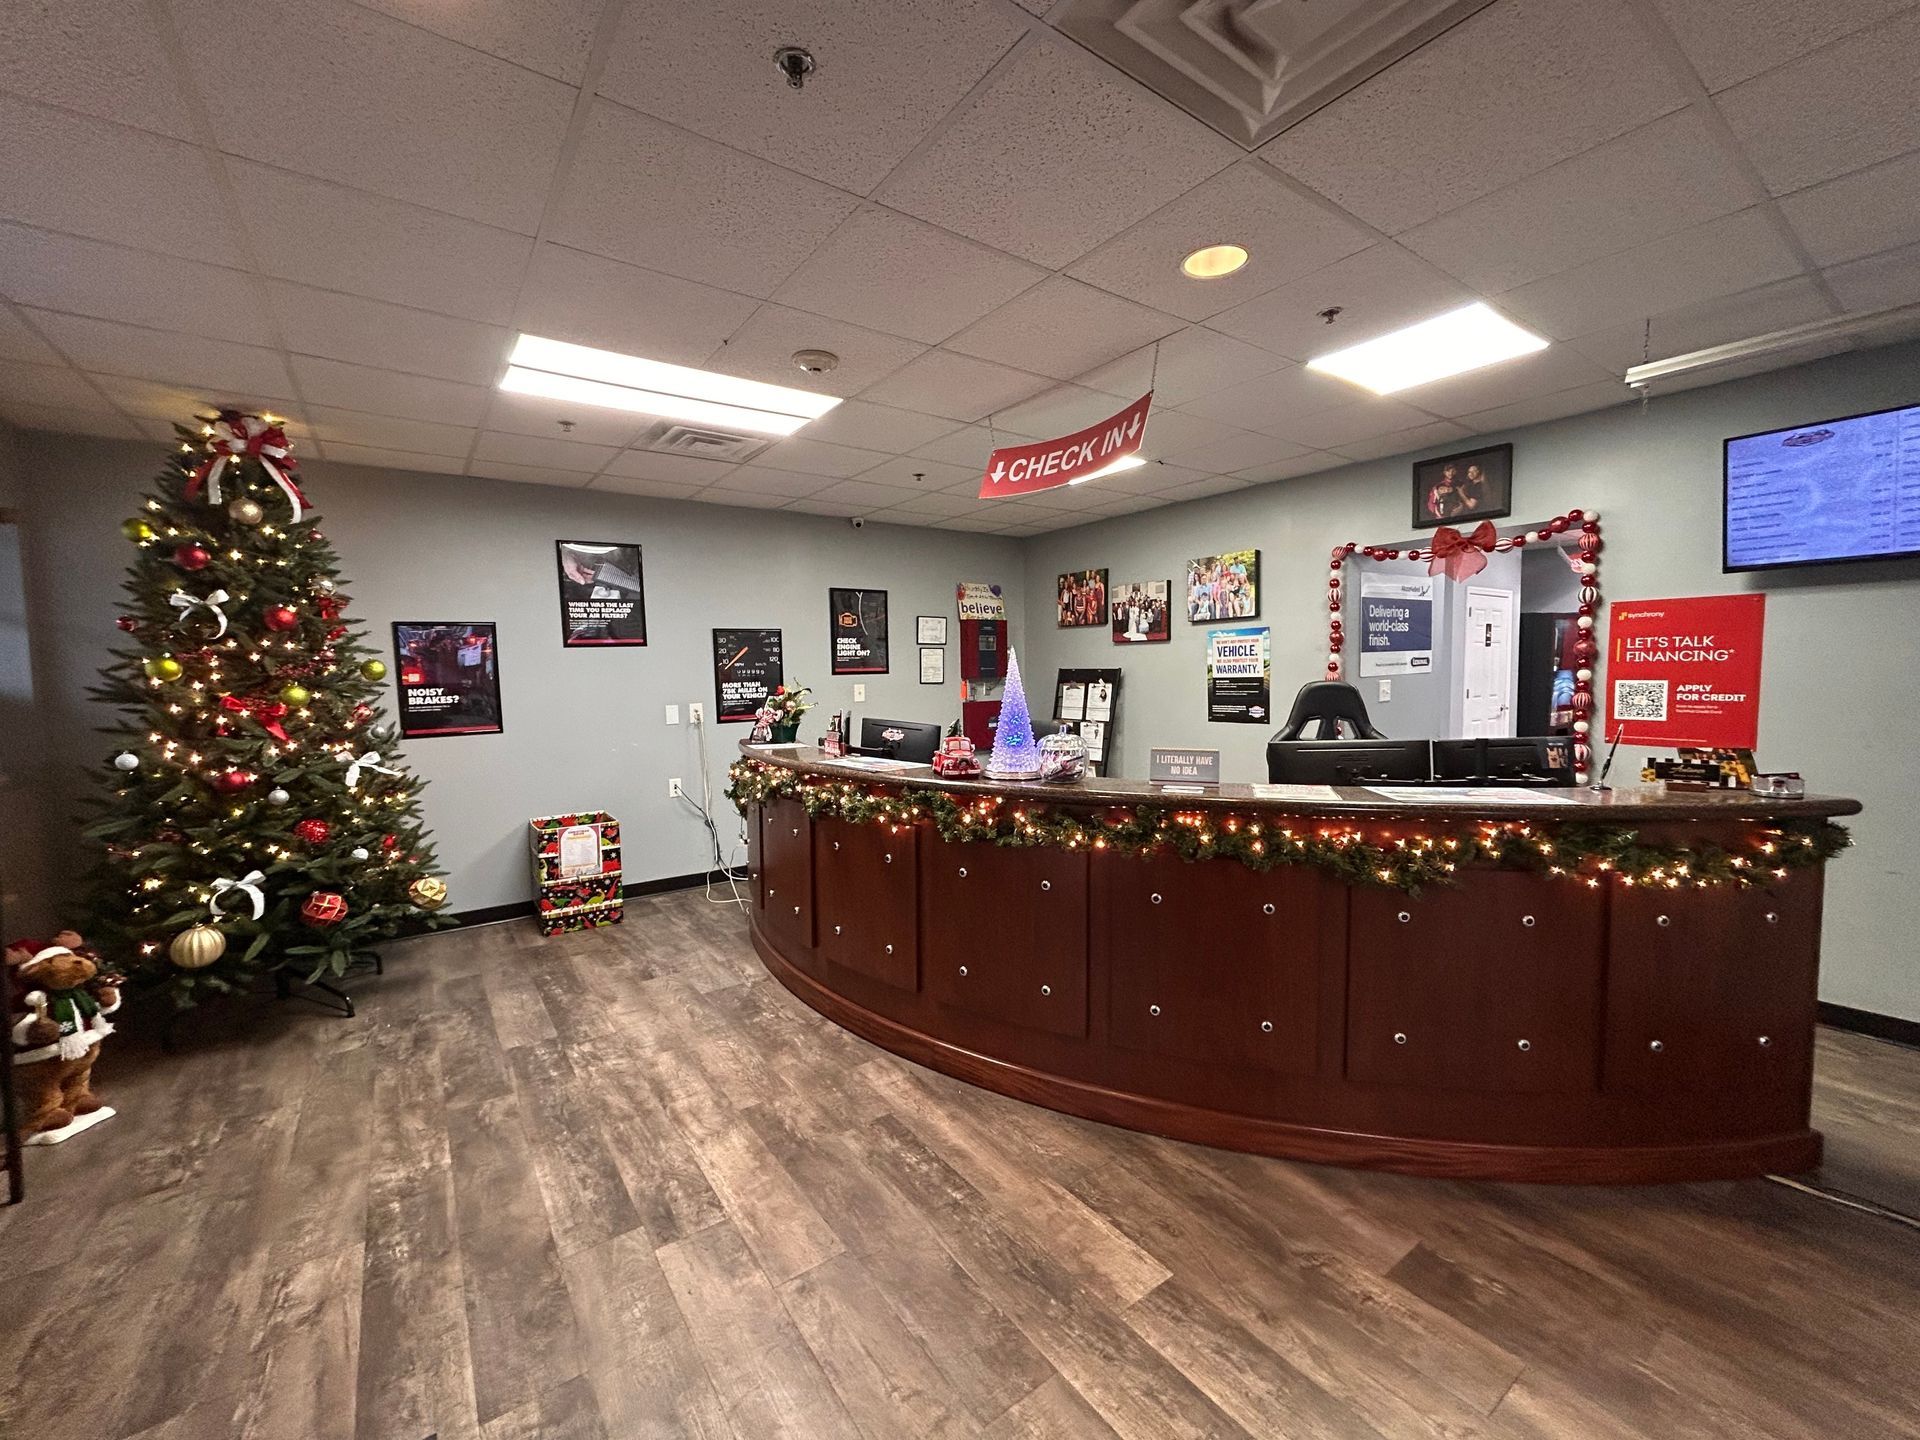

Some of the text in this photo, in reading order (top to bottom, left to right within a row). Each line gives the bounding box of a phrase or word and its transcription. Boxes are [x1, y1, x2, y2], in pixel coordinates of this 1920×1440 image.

[1008, 421, 1128, 482] CHECK IN
[960, 602, 1002, 614] believe
[1369, 604, 1410, 620] Delivering a
[1369, 620, 1409, 632] world-class
[1369, 634, 1390, 646] finish.
[1626, 636, 1714, 648] LET'S TALK
[1217, 644, 1258, 657] VEHICLE.
[1216, 664, 1260, 674] WARRANTY.
[408, 688, 444, 696] NOISY
[408, 695, 460, 705] BRAKES?
[1161, 755, 1194, 765] LITERALLY
[1196, 756, 1213, 765] HAVE
[1170, 766, 1198, 775] NO IDEA
